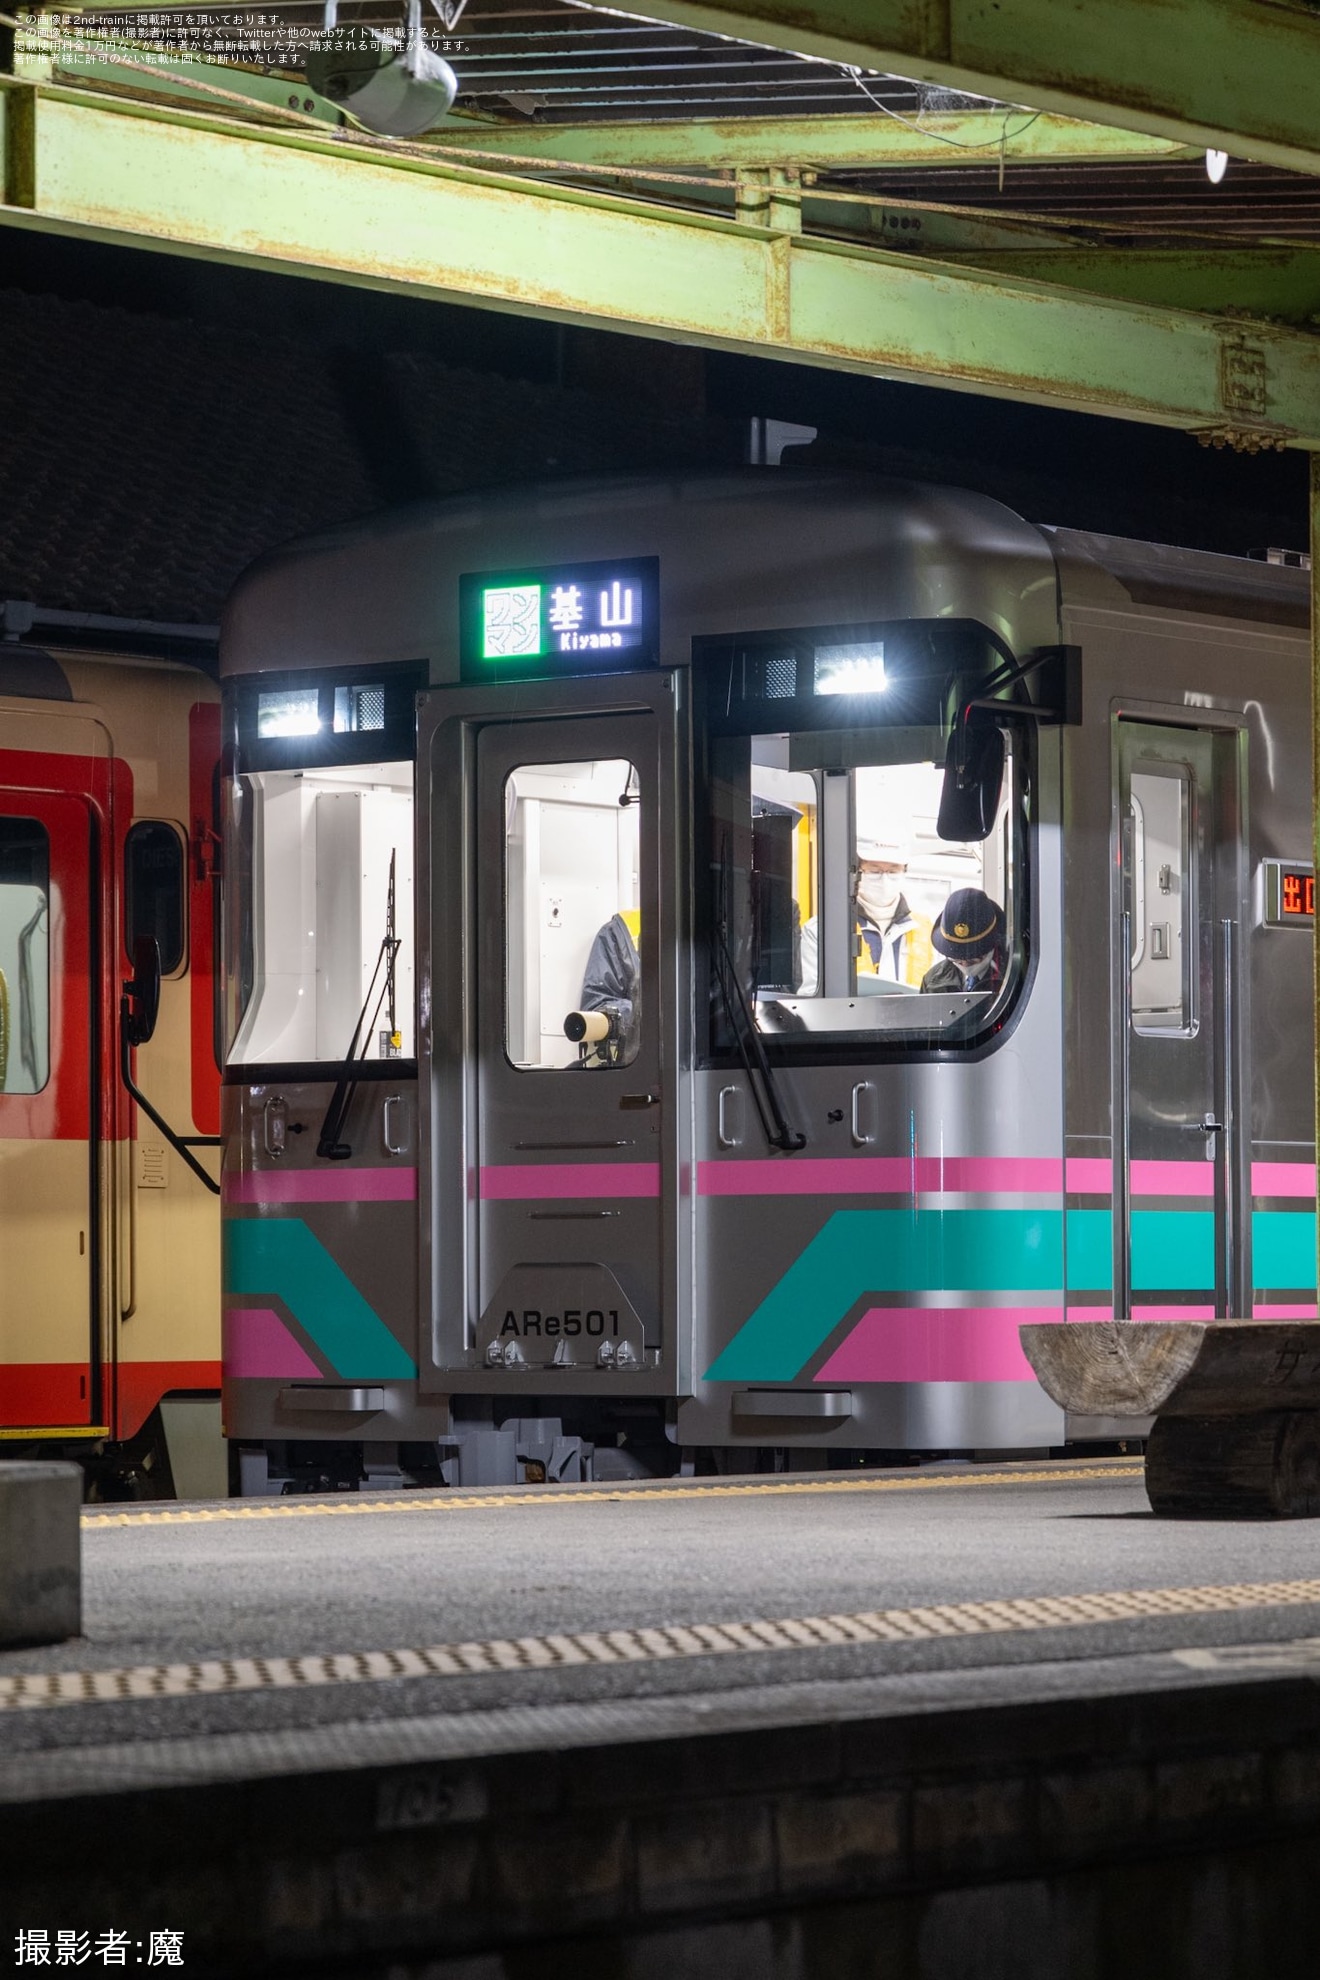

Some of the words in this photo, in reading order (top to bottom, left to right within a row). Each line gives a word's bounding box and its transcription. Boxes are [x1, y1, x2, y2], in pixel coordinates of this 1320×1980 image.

[549, 581, 633, 631] 基山
[560, 631, 622, 651] Kiyama
[500, 1309, 619, 1337] ARe501
